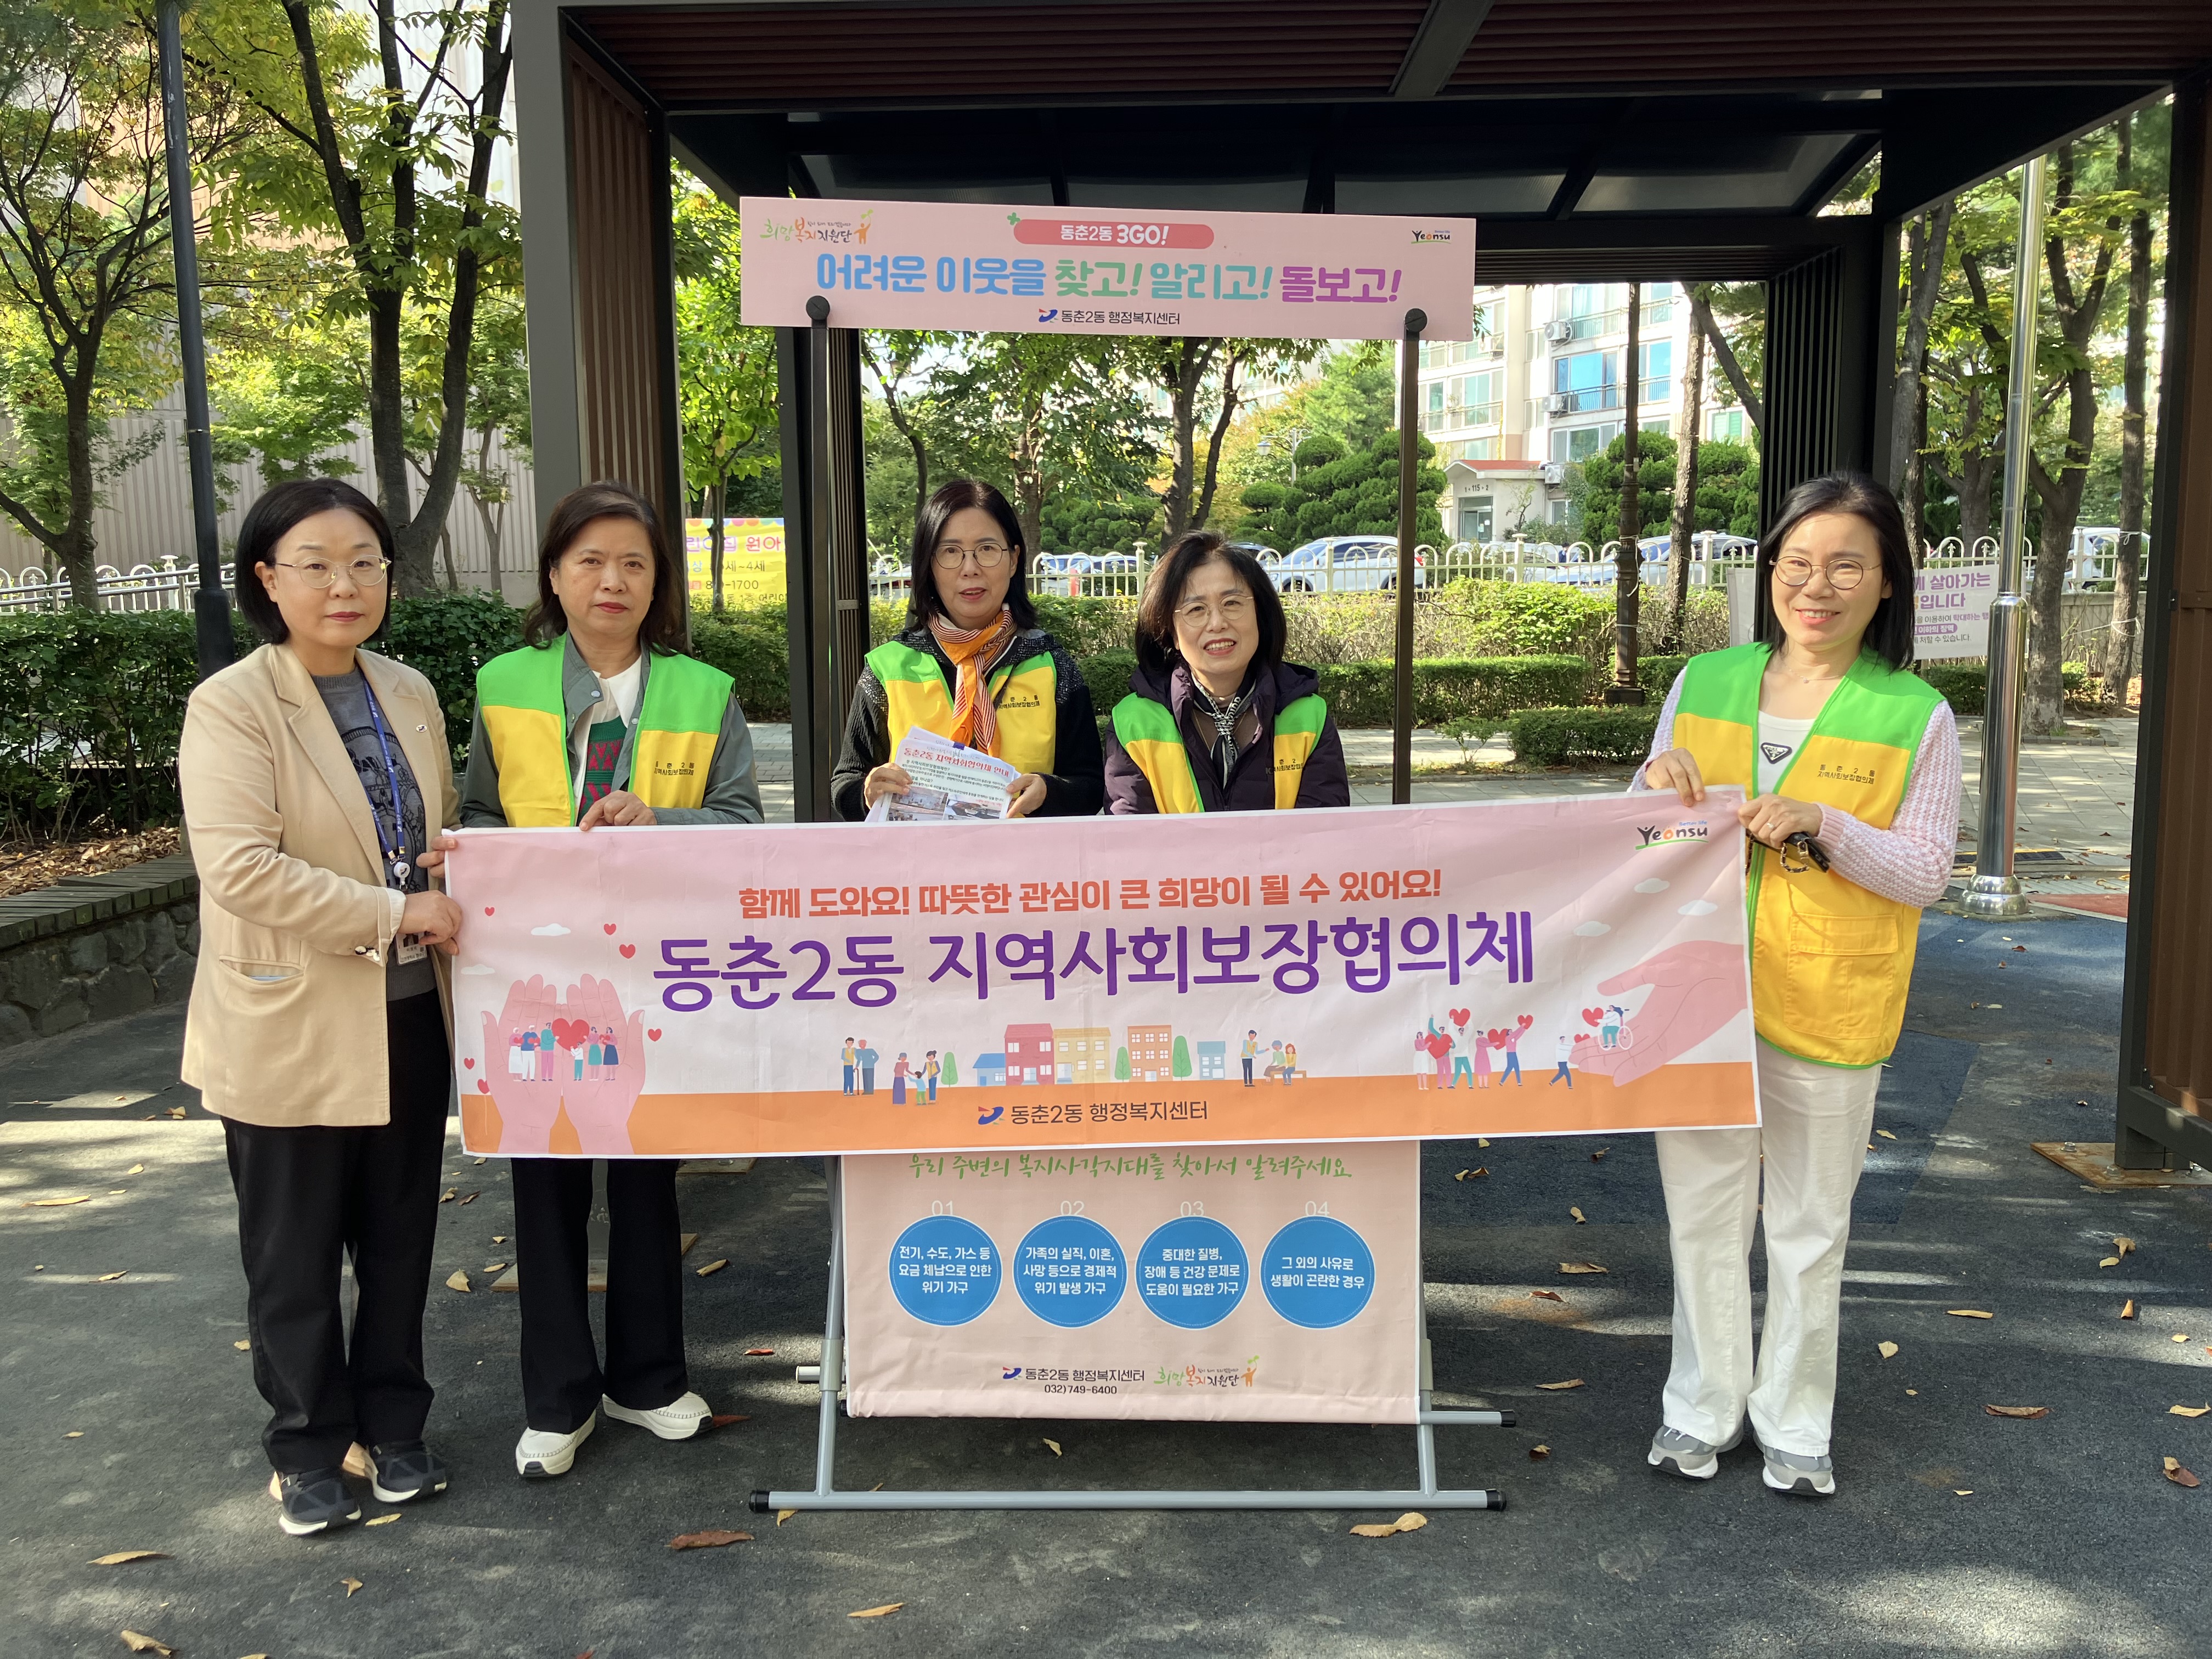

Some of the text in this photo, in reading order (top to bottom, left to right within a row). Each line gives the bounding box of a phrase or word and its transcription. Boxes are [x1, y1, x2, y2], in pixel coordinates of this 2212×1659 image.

[760, 217, 852, 243] 희망복지지원단
[1060, 225, 1169, 245] 동춘2동 3GO!
[1412, 230, 1451, 242] Yeonsu
[817, 253, 1402, 303] 어려운 이웃을 찾고! 알리고! 돌보고!
[1062, 309, 1180, 325] 동춘2동 행정복지센터
[1930, 573, 1990, 590] 살아가는
[1637, 825, 1708, 846] Yeonsu
[738, 869, 1442, 919] 함께 도와요! 따뜻한 관심이 큰 희망이 될 수 있어요!
[653, 911, 1533, 1012] 동춘2동 지역사회보장협의체
[1011, 1101, 1208, 1125] 동춘2동 행정복지센터
[909, 1154, 944, 1178] 우리
[952, 1155, 1009, 1180] 주변의
[1019, 1153, 1165, 1181] 복지사각지대를
[1172, 1152, 1237, 1178] 찾아서
[931, 1200, 954, 1216] 01
[1060, 1200, 1085, 1217] 02
[1180, 1200, 1205, 1217] 03
[1305, 1201, 1330, 1217] 04
[900, 1246, 990, 1260] 전기, 수도, 가스 등
[1025, 1246, 1114, 1261] 가족의 실직, 이혼,
[1162, 1248, 1223, 1261] 중대한 질병,
[899, 1264, 992, 1278] 요금 체납으로 인한
[1023, 1265, 1117, 1279] 사망 등으로 경제적
[1144, 1265, 1240, 1279] 장애 등 건강 문제로
[1282, 1257, 1353, 1271] 그 외의 사유로
[922, 1281, 969, 1295] 위기 가구
[1034, 1282, 1106, 1295] 위기 발생 가구
[1146, 1282, 1239, 1296] 도움이 필요한 가구
[1271, 1274, 1365, 1289] 생활이 곤란한 경우
[1025, 1368, 1146, 1383] 동춘2동 행정복지센터
[1153, 1364, 1239, 1387] 희망복지지원단
[1045, 1384, 1117, 1395] 032)749-6400
